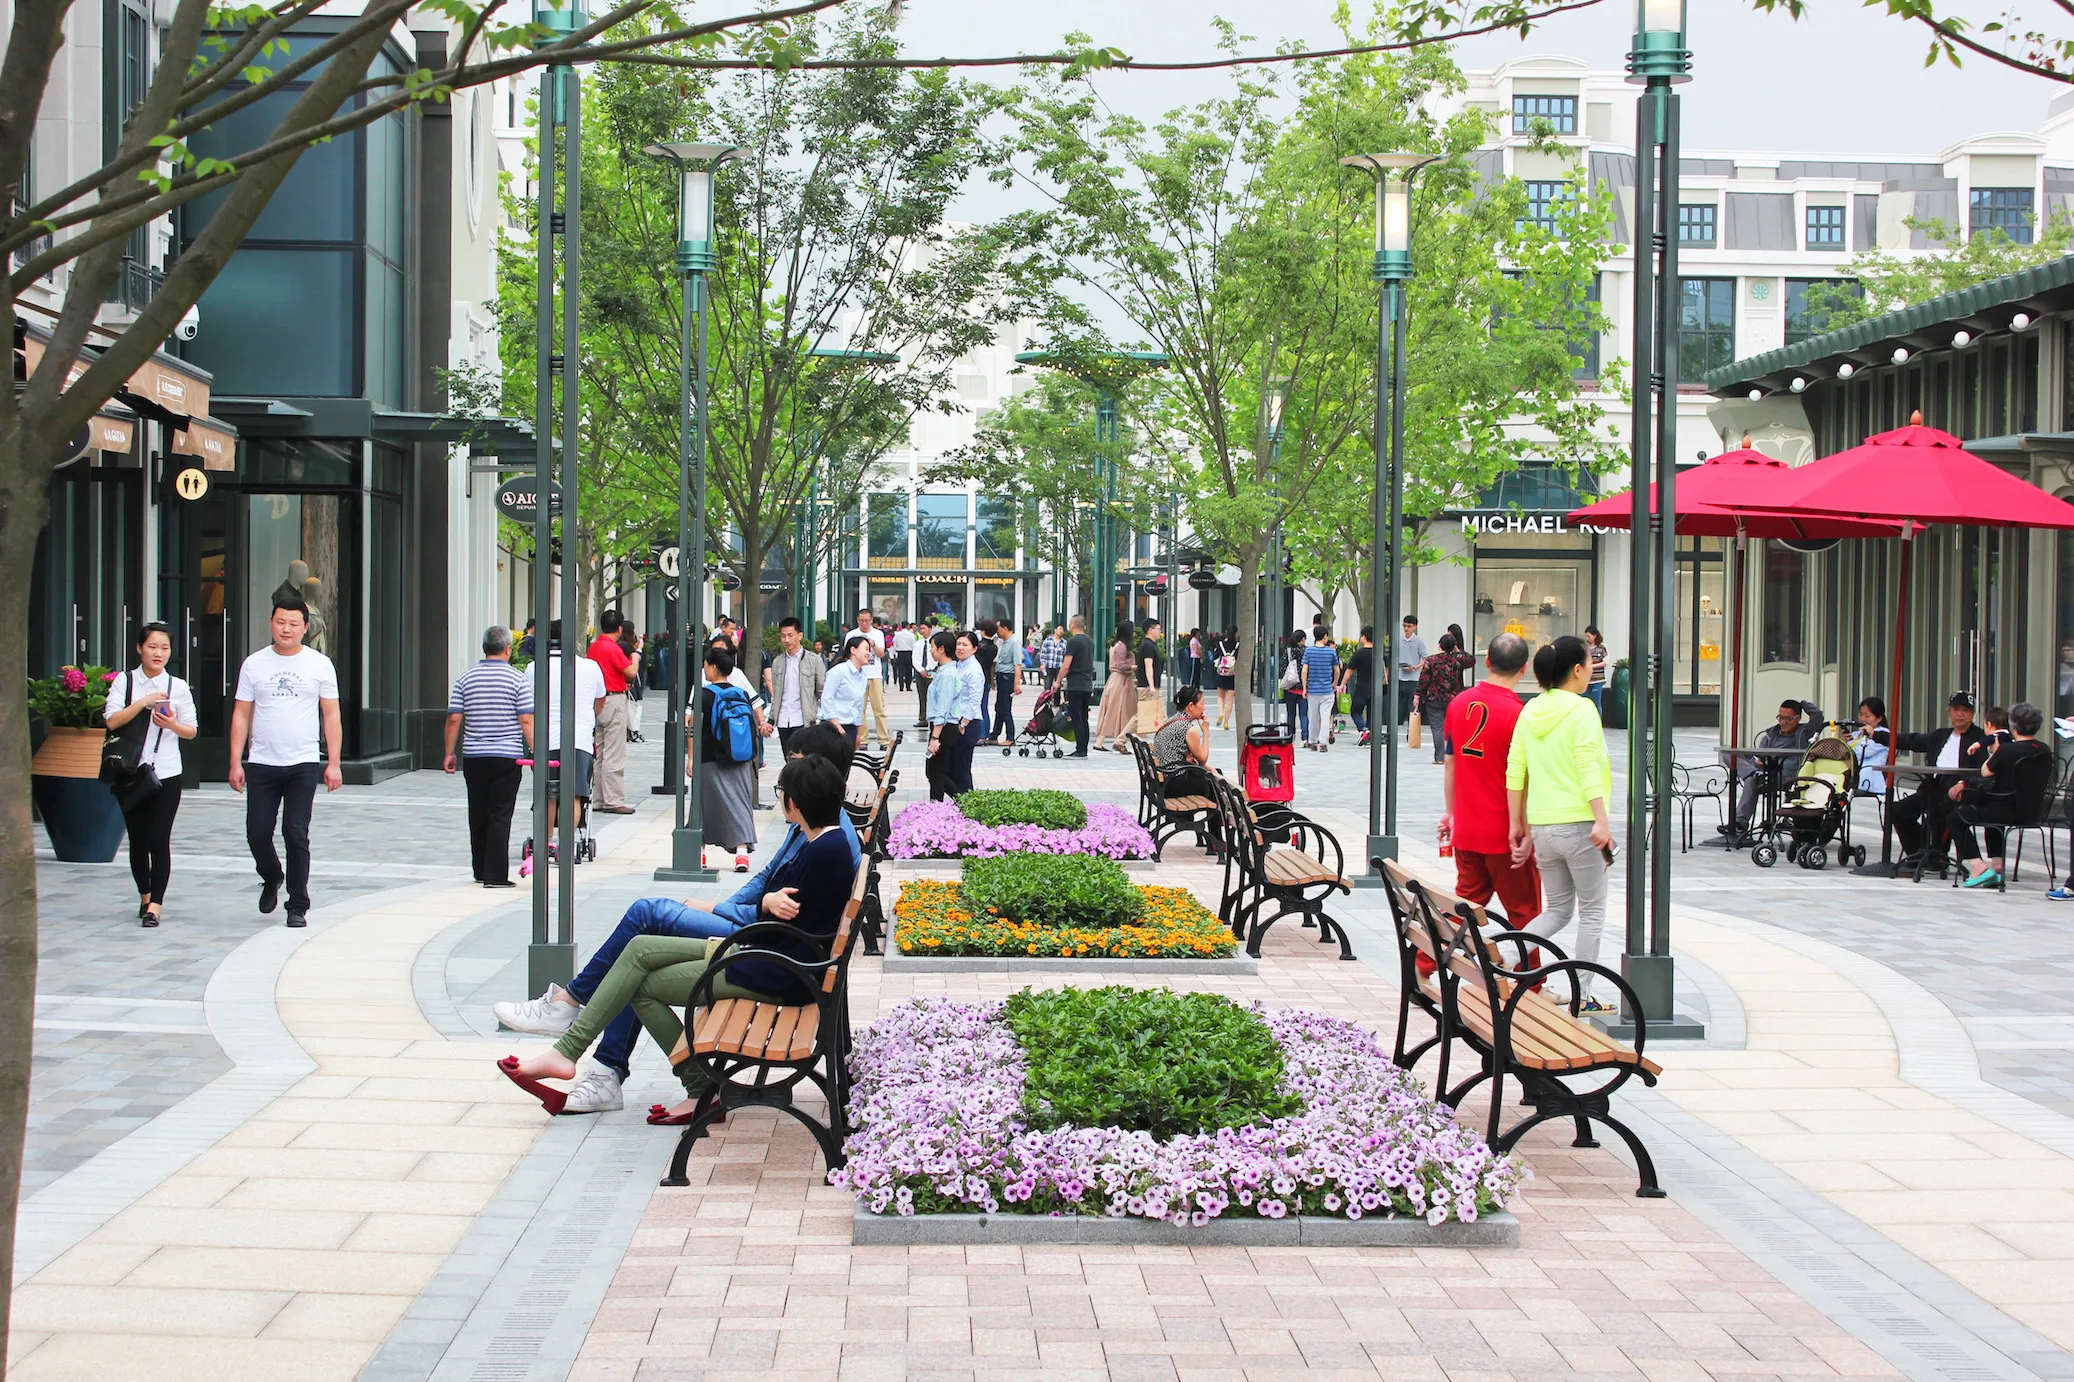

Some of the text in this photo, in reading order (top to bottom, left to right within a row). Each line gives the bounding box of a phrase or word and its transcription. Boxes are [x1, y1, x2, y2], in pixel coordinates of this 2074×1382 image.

[1461, 515, 1567, 534] MICHAEL
[915, 575, 968, 583] COACH
[1461, 701, 1489, 759] 2
